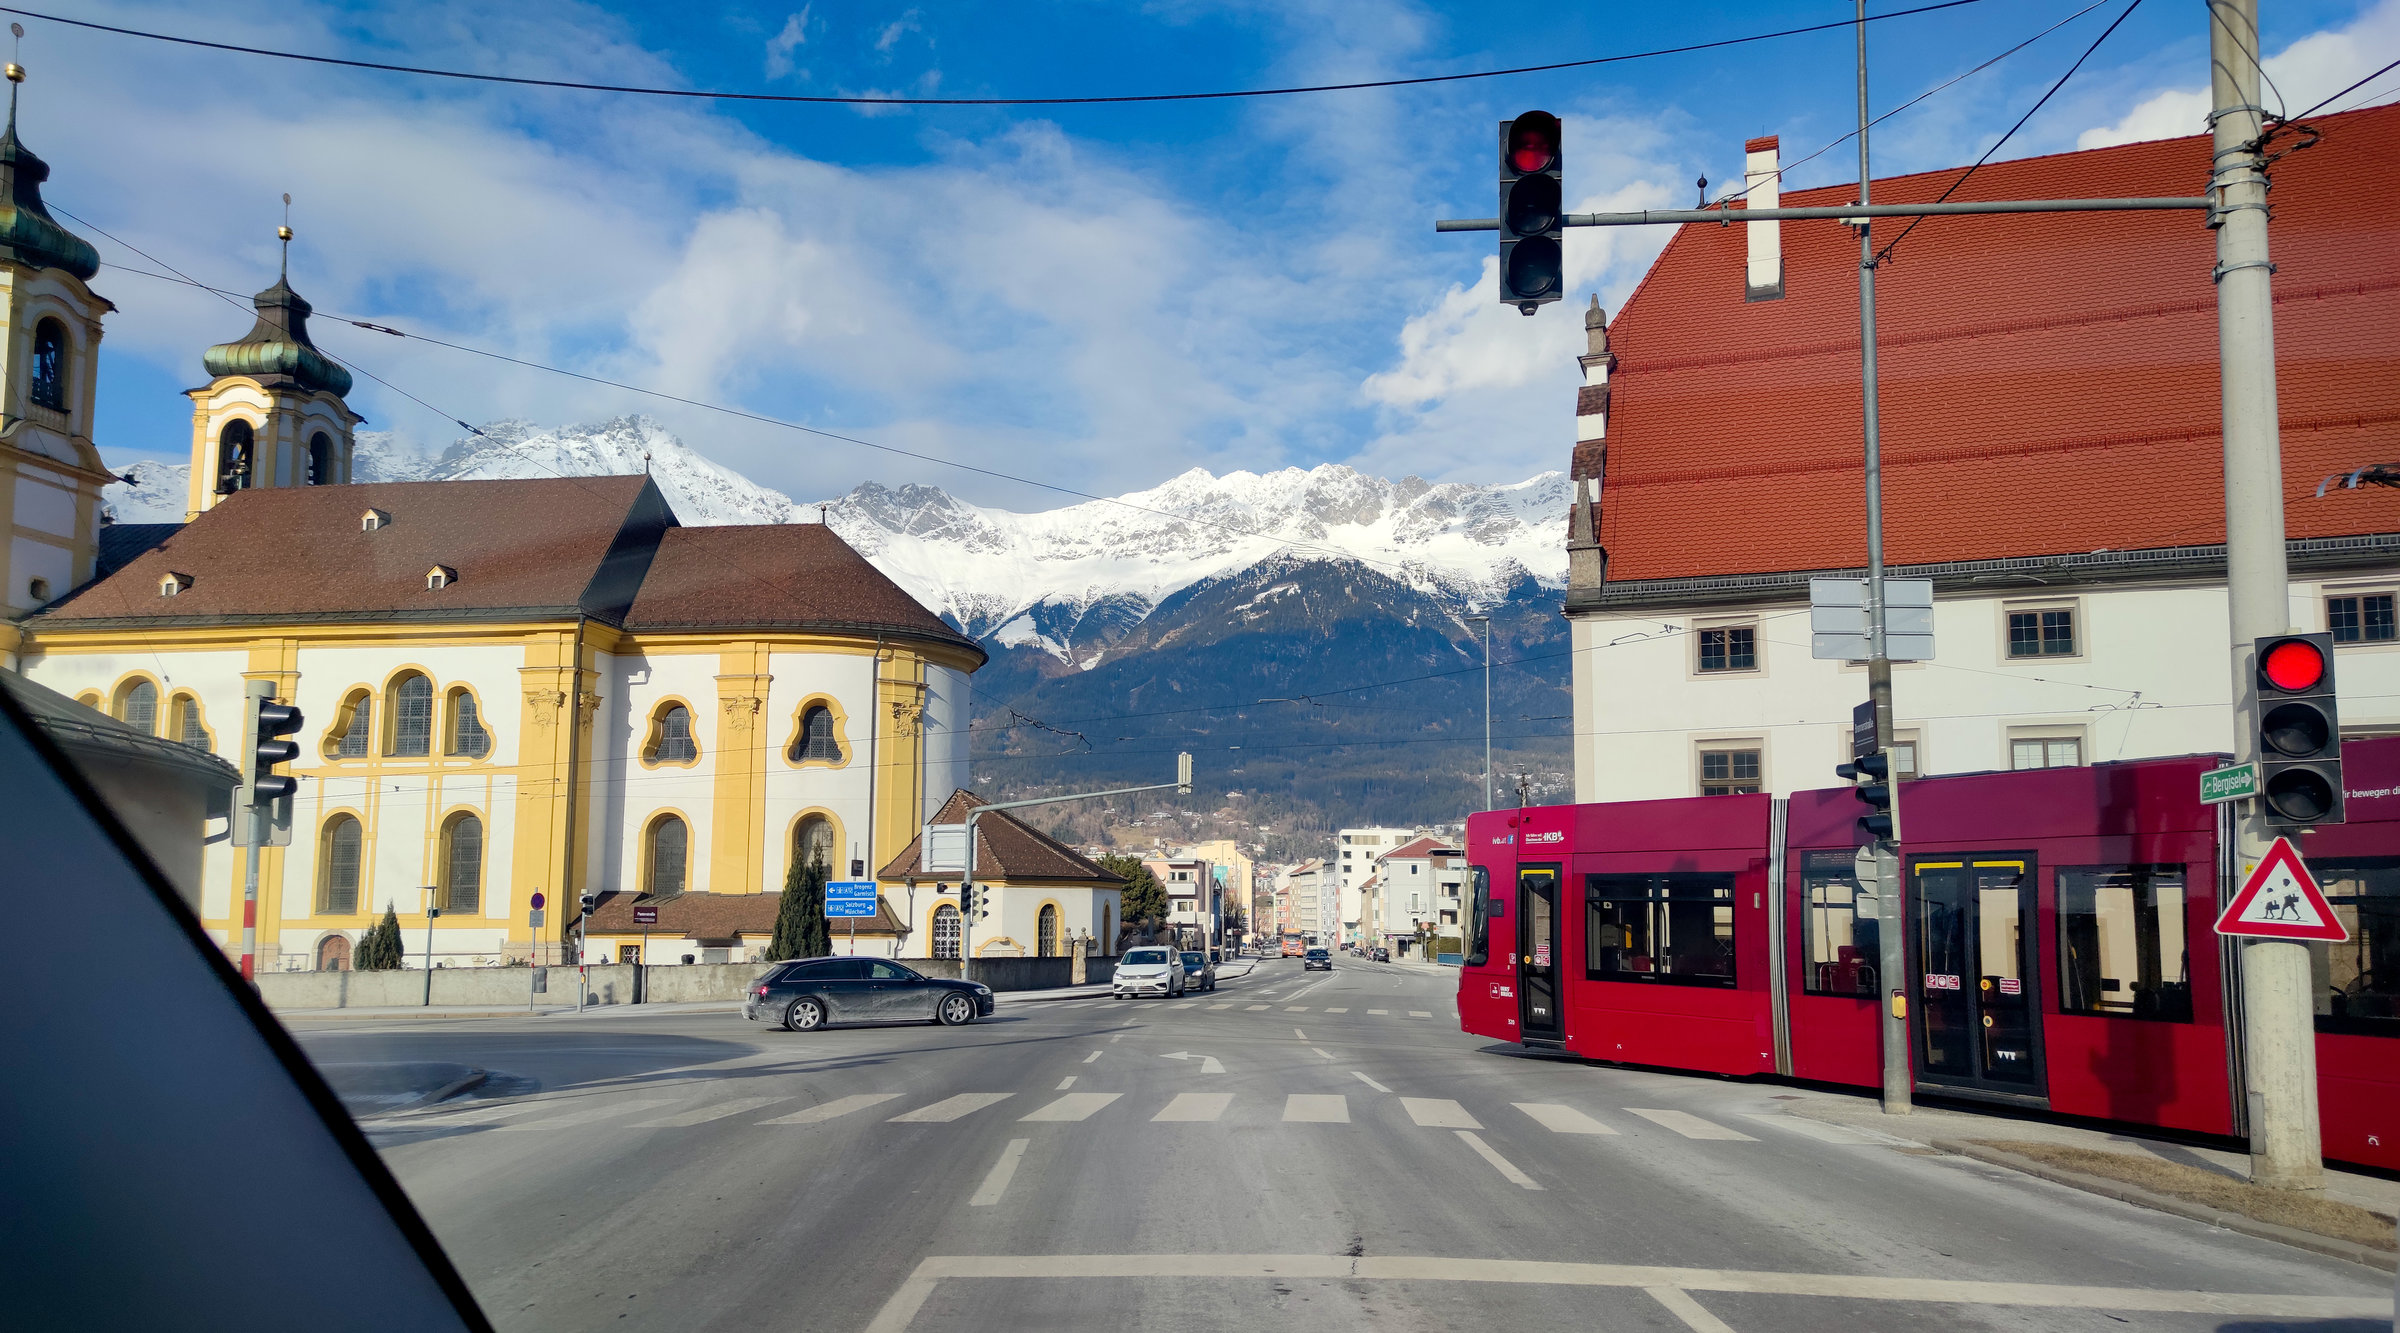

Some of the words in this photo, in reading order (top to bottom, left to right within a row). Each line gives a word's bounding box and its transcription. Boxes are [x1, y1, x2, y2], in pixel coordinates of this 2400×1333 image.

[2212, 770, 2242, 795] Bergisel
[2352, 788, 2390, 799] bewegen
[854, 884, 872, 892] Bregenz
